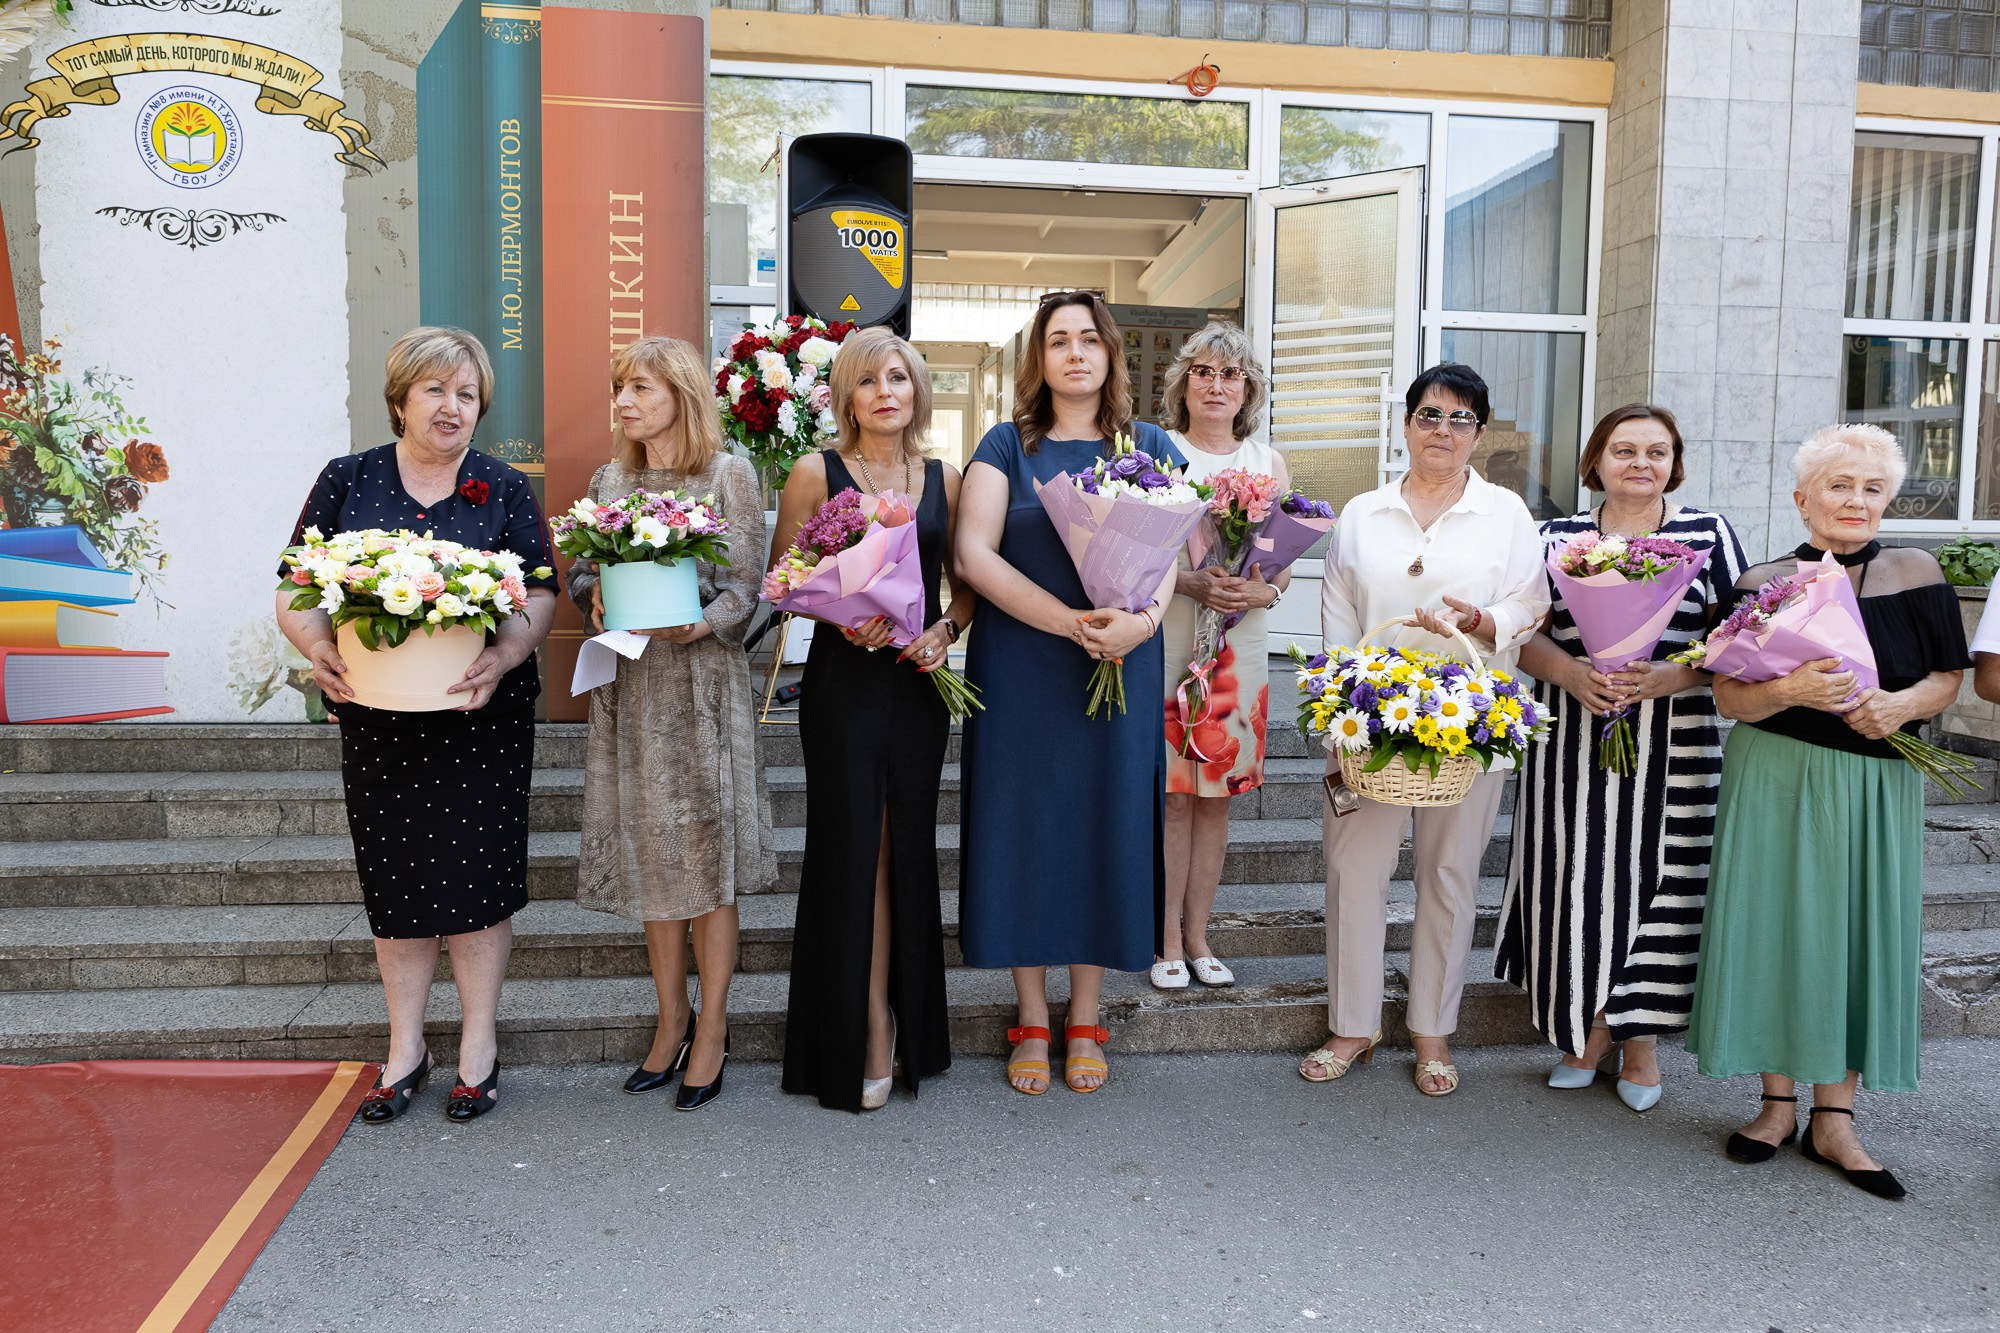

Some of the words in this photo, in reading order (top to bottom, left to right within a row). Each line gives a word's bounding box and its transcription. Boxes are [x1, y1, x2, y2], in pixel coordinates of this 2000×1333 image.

[65, 54, 88, 72] ТОТ
[89, 45, 134, 67] САМЫЙ
[136, 46, 170, 62] ДЕНЬ,
[172, 46, 229, 65] КОТОРОГО
[231, 52, 252, 69] МЫ
[148, 95, 167, 111] №8
[168, 91, 205, 101] имени
[173, 173, 208, 185] ГБОУ
[500, 118, 523, 351] М.Ю.ЛЕРМОНТОВ
[839, 228, 898, 249] 1000
[869, 248, 898, 257] WATTS
[609, 190, 644, 433] ШКИН
